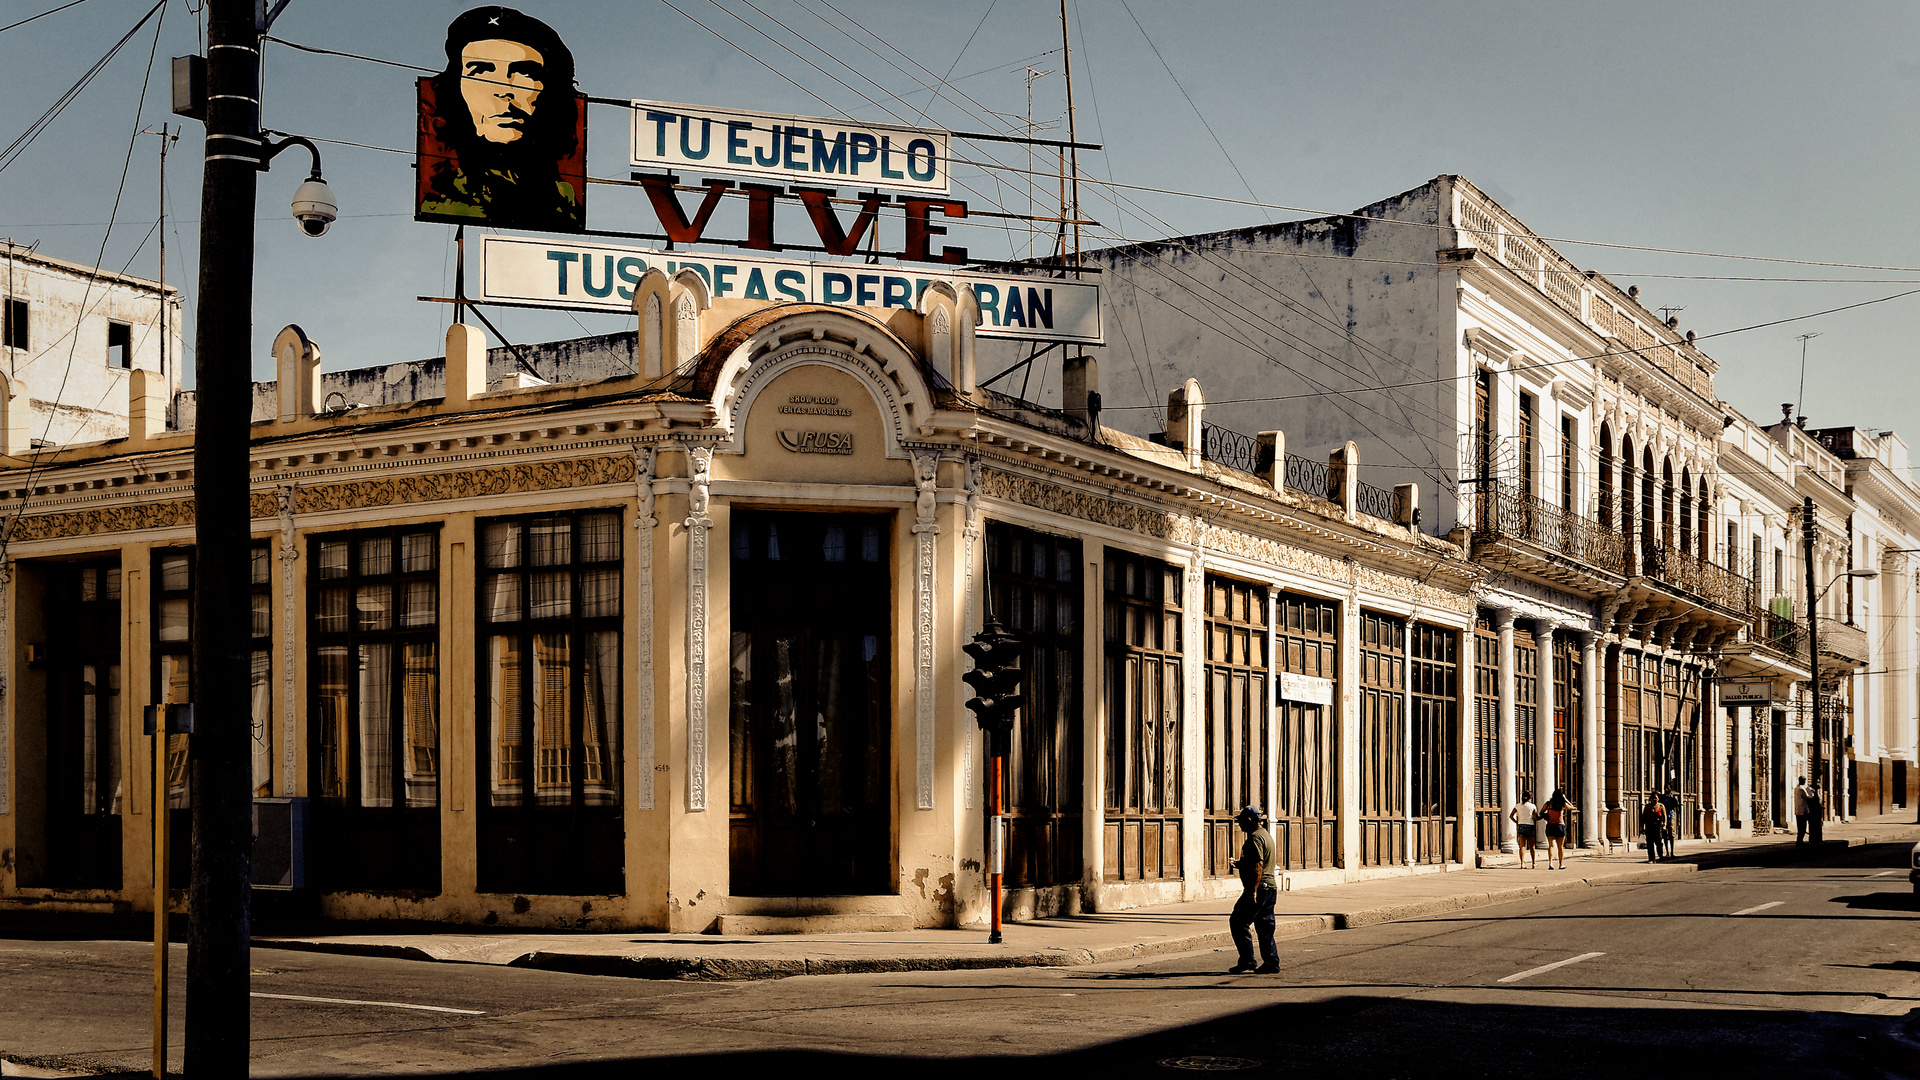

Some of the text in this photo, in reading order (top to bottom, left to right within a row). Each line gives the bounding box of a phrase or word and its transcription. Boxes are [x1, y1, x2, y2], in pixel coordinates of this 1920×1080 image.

[646, 111, 936, 182] TU EJEMPLO
[631, 172, 967, 265] VIVE
[823, 272, 1054, 329] PERRAN
[778, 406, 851, 416] VENTAS MAYORISTAS
[789, 395, 812, 404] SHOW
[800, 431, 853, 449] FUSA
